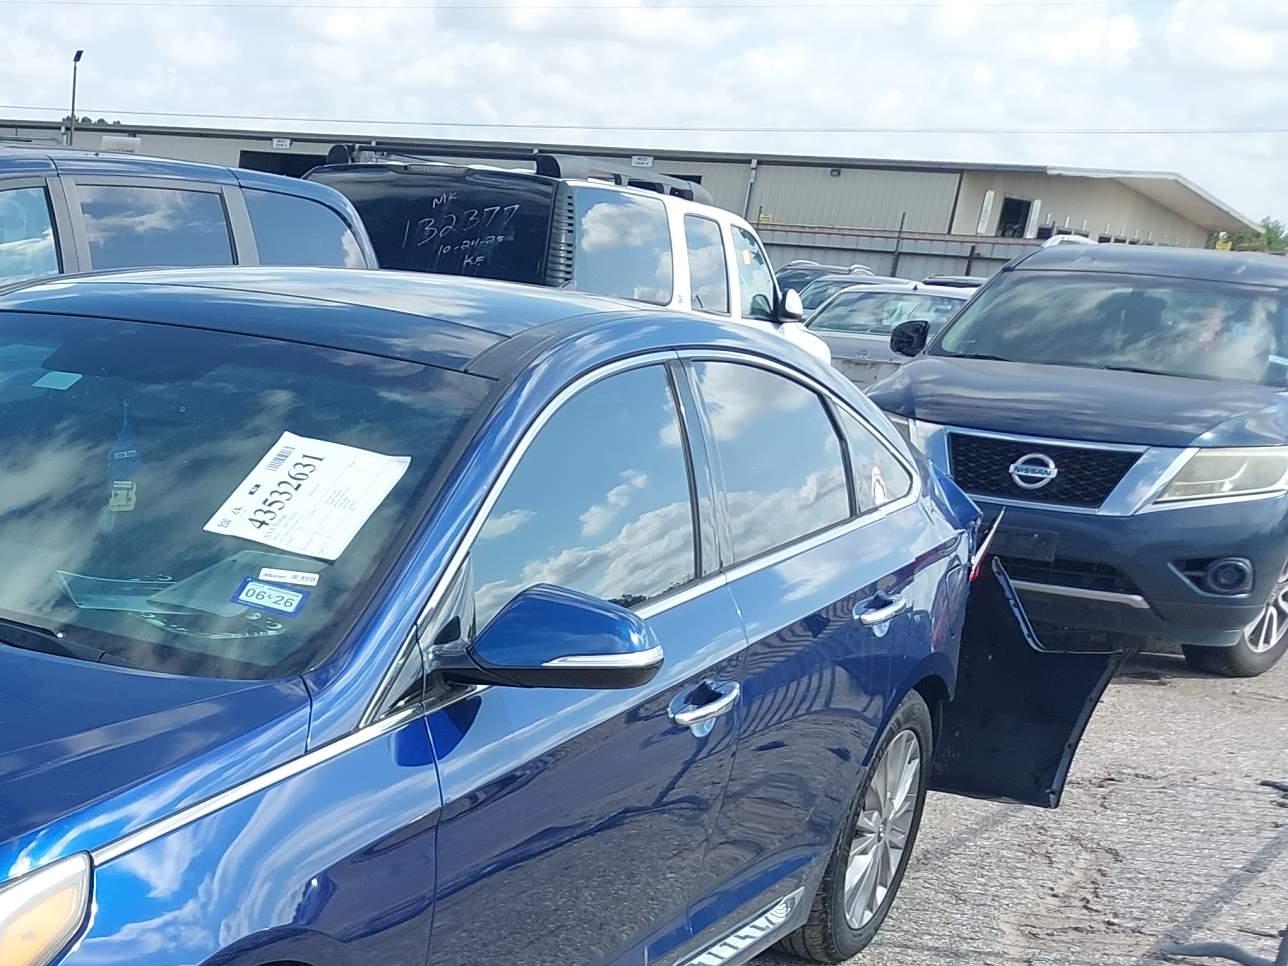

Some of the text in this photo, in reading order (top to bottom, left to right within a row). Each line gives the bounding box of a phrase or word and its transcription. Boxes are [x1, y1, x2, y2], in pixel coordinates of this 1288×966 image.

[402, 204, 520, 248] 132377
[248, 453, 326, 529] 43532631
[1014, 465, 1052, 476] NISSAN
